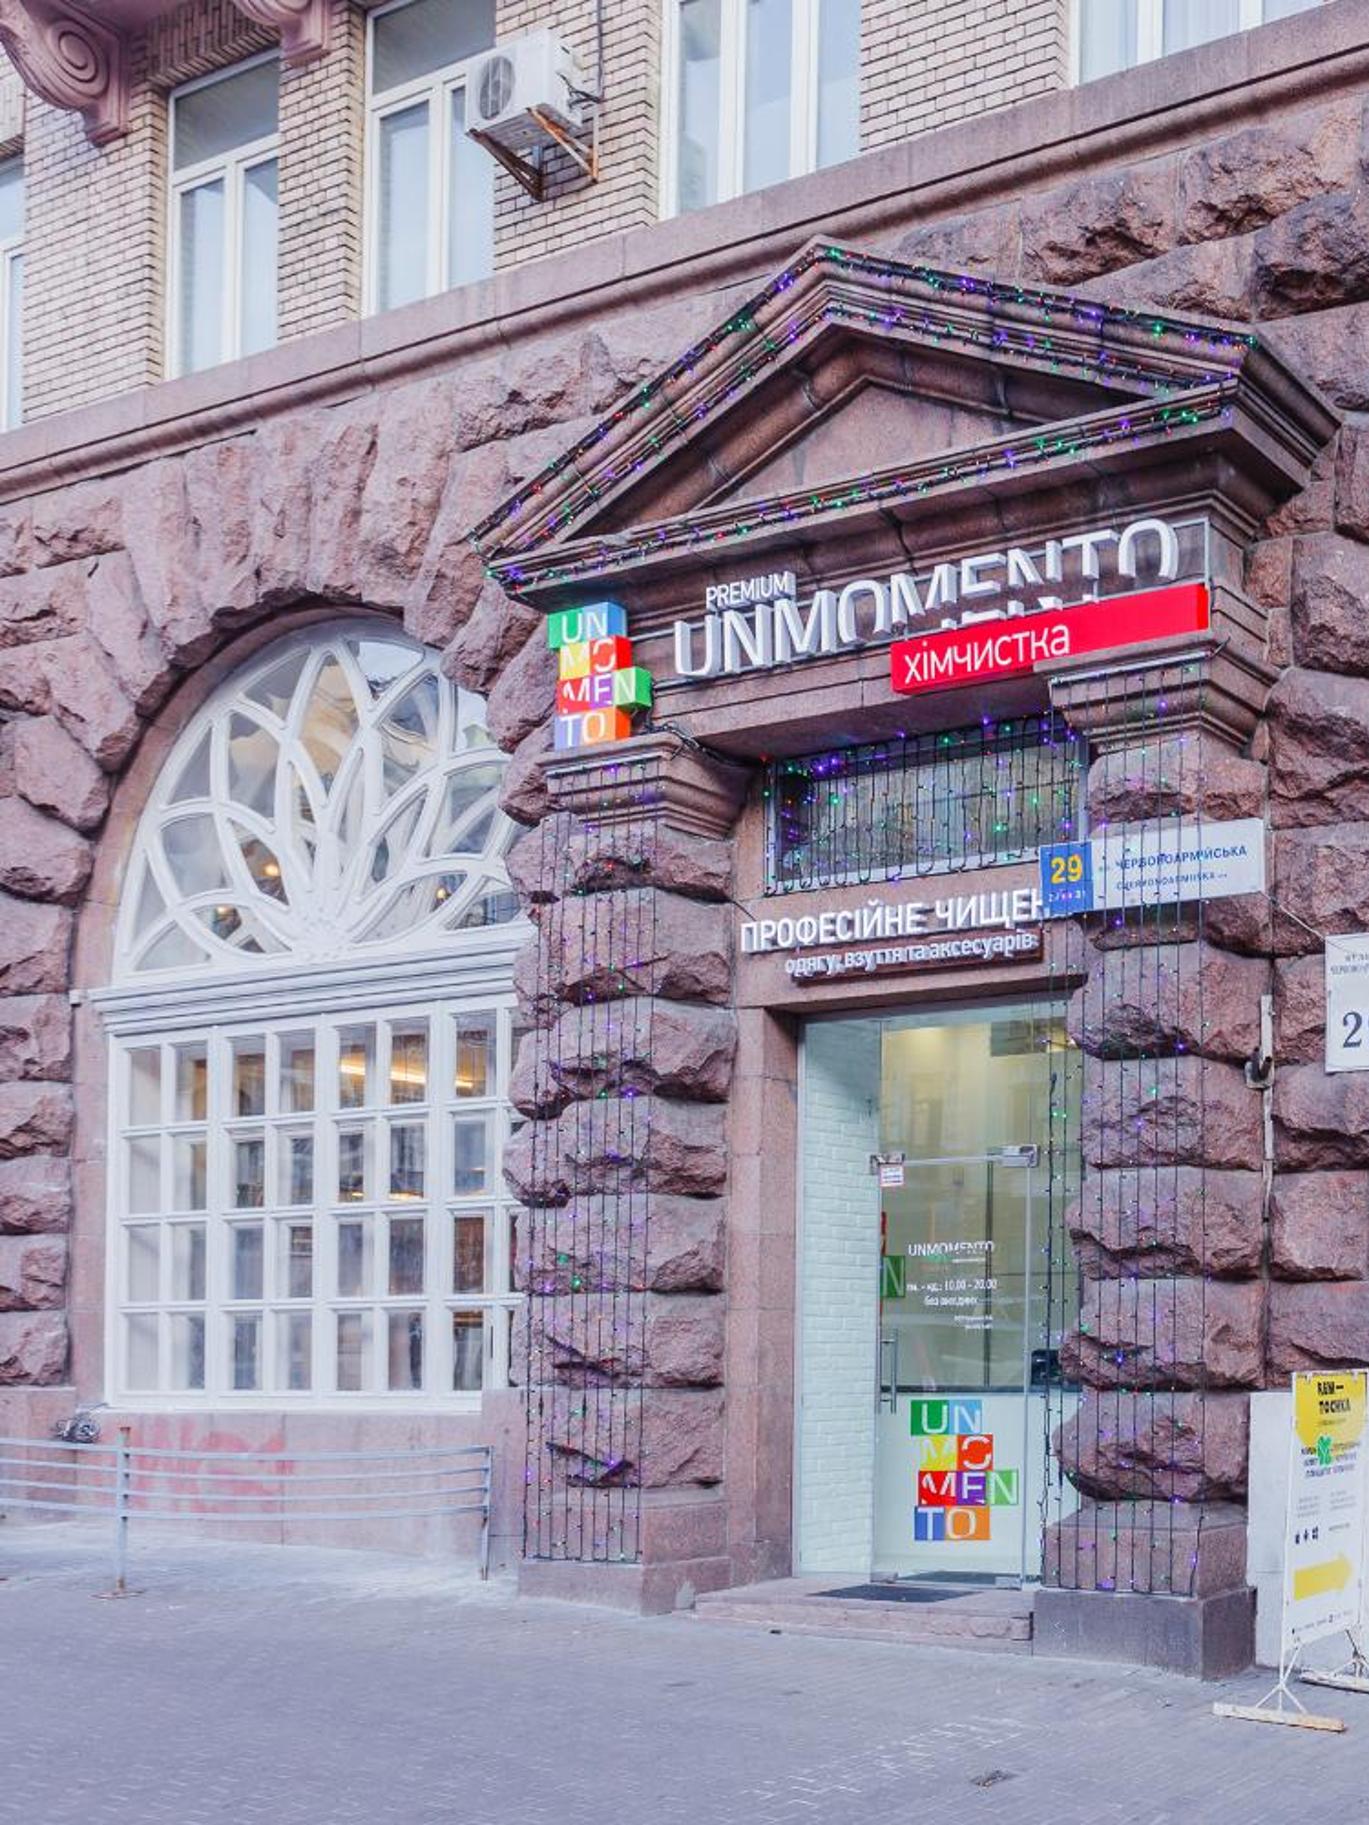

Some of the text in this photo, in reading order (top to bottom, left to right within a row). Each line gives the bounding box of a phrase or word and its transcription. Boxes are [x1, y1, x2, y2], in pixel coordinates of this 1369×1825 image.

[674, 518, 1179, 677] UNMOMENTO
[705, 571, 795, 609] PREMIUM
[561, 611, 609, 642] UN
[561, 669, 637, 713] MEN
[560, 712, 607, 747] TO
[1051, 854, 1083, 885] 29
[740, 900, 925, 954] ПРОФЕСІЙНЕ
[845, 947, 902, 970] взуття
[903, 944, 929, 961] та
[929, 930, 1038, 959] аксесуарів
[921, 1404, 982, 1434] UN
[921, 1471, 1017, 1505] MEN
[917, 1506, 977, 1540] TO
